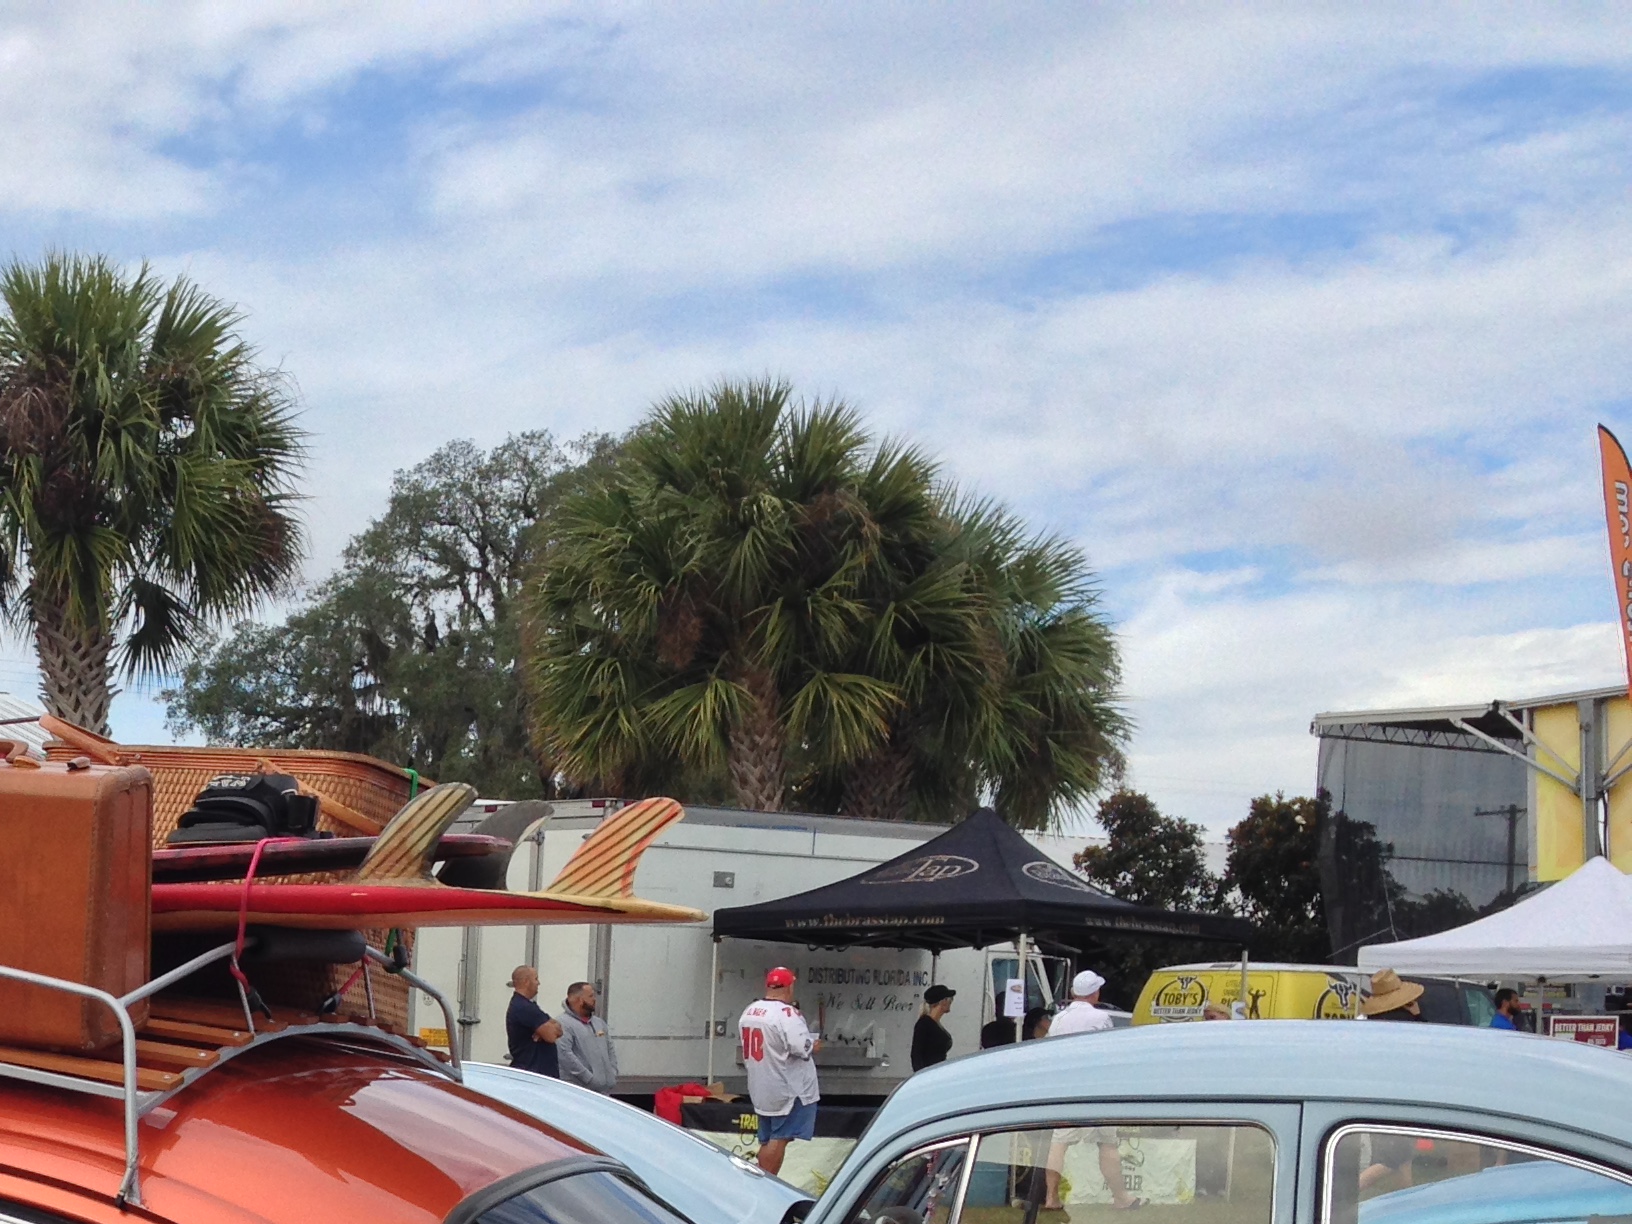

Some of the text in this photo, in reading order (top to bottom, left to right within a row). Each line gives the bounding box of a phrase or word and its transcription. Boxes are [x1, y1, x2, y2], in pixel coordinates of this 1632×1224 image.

[808, 966, 870, 985] DISTRIBUTING
[873, 969, 910, 987] FLORIDA
[1162, 992, 1198, 1006] TOBY'S
